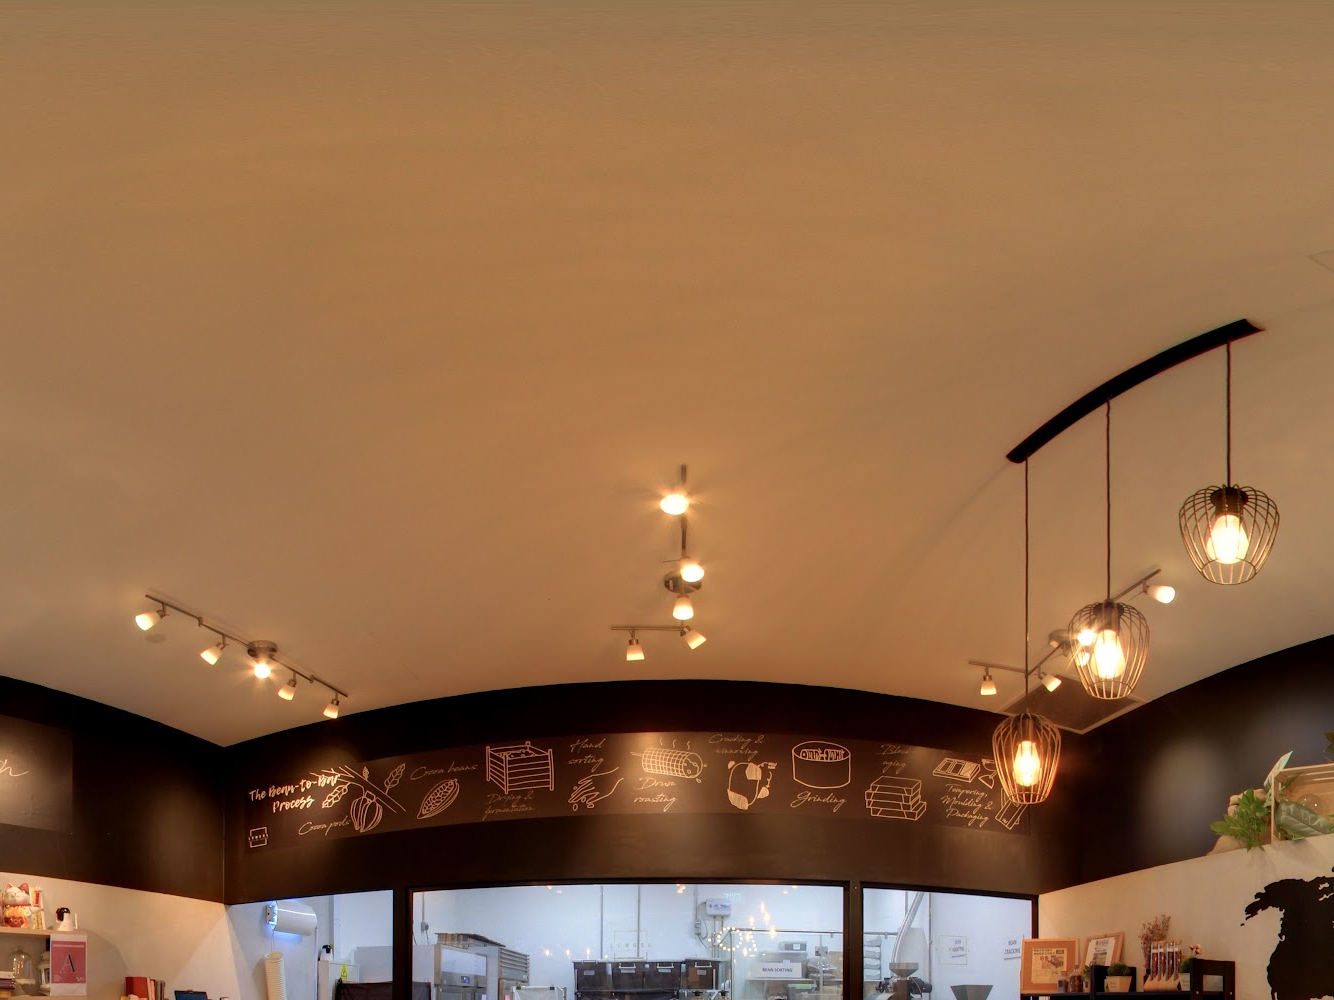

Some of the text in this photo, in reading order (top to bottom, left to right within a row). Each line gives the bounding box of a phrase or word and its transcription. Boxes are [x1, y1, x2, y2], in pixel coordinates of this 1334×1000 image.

[570, 738, 606, 751] Hand
[708, 734, 752, 749] Cracking
[410, 761, 478, 780] Cocoa beans
[568, 757, 605, 772] sorting
[882, 760, 907, 773] aging
[248, 774, 340, 802] The Bean-to-Bar
[634, 777, 676, 790] Drum
[272, 795, 315, 813] Process
[633, 794, 676, 812] roasting
[790, 791, 847, 812] Grinding
[60, 953, 76, 973] A
